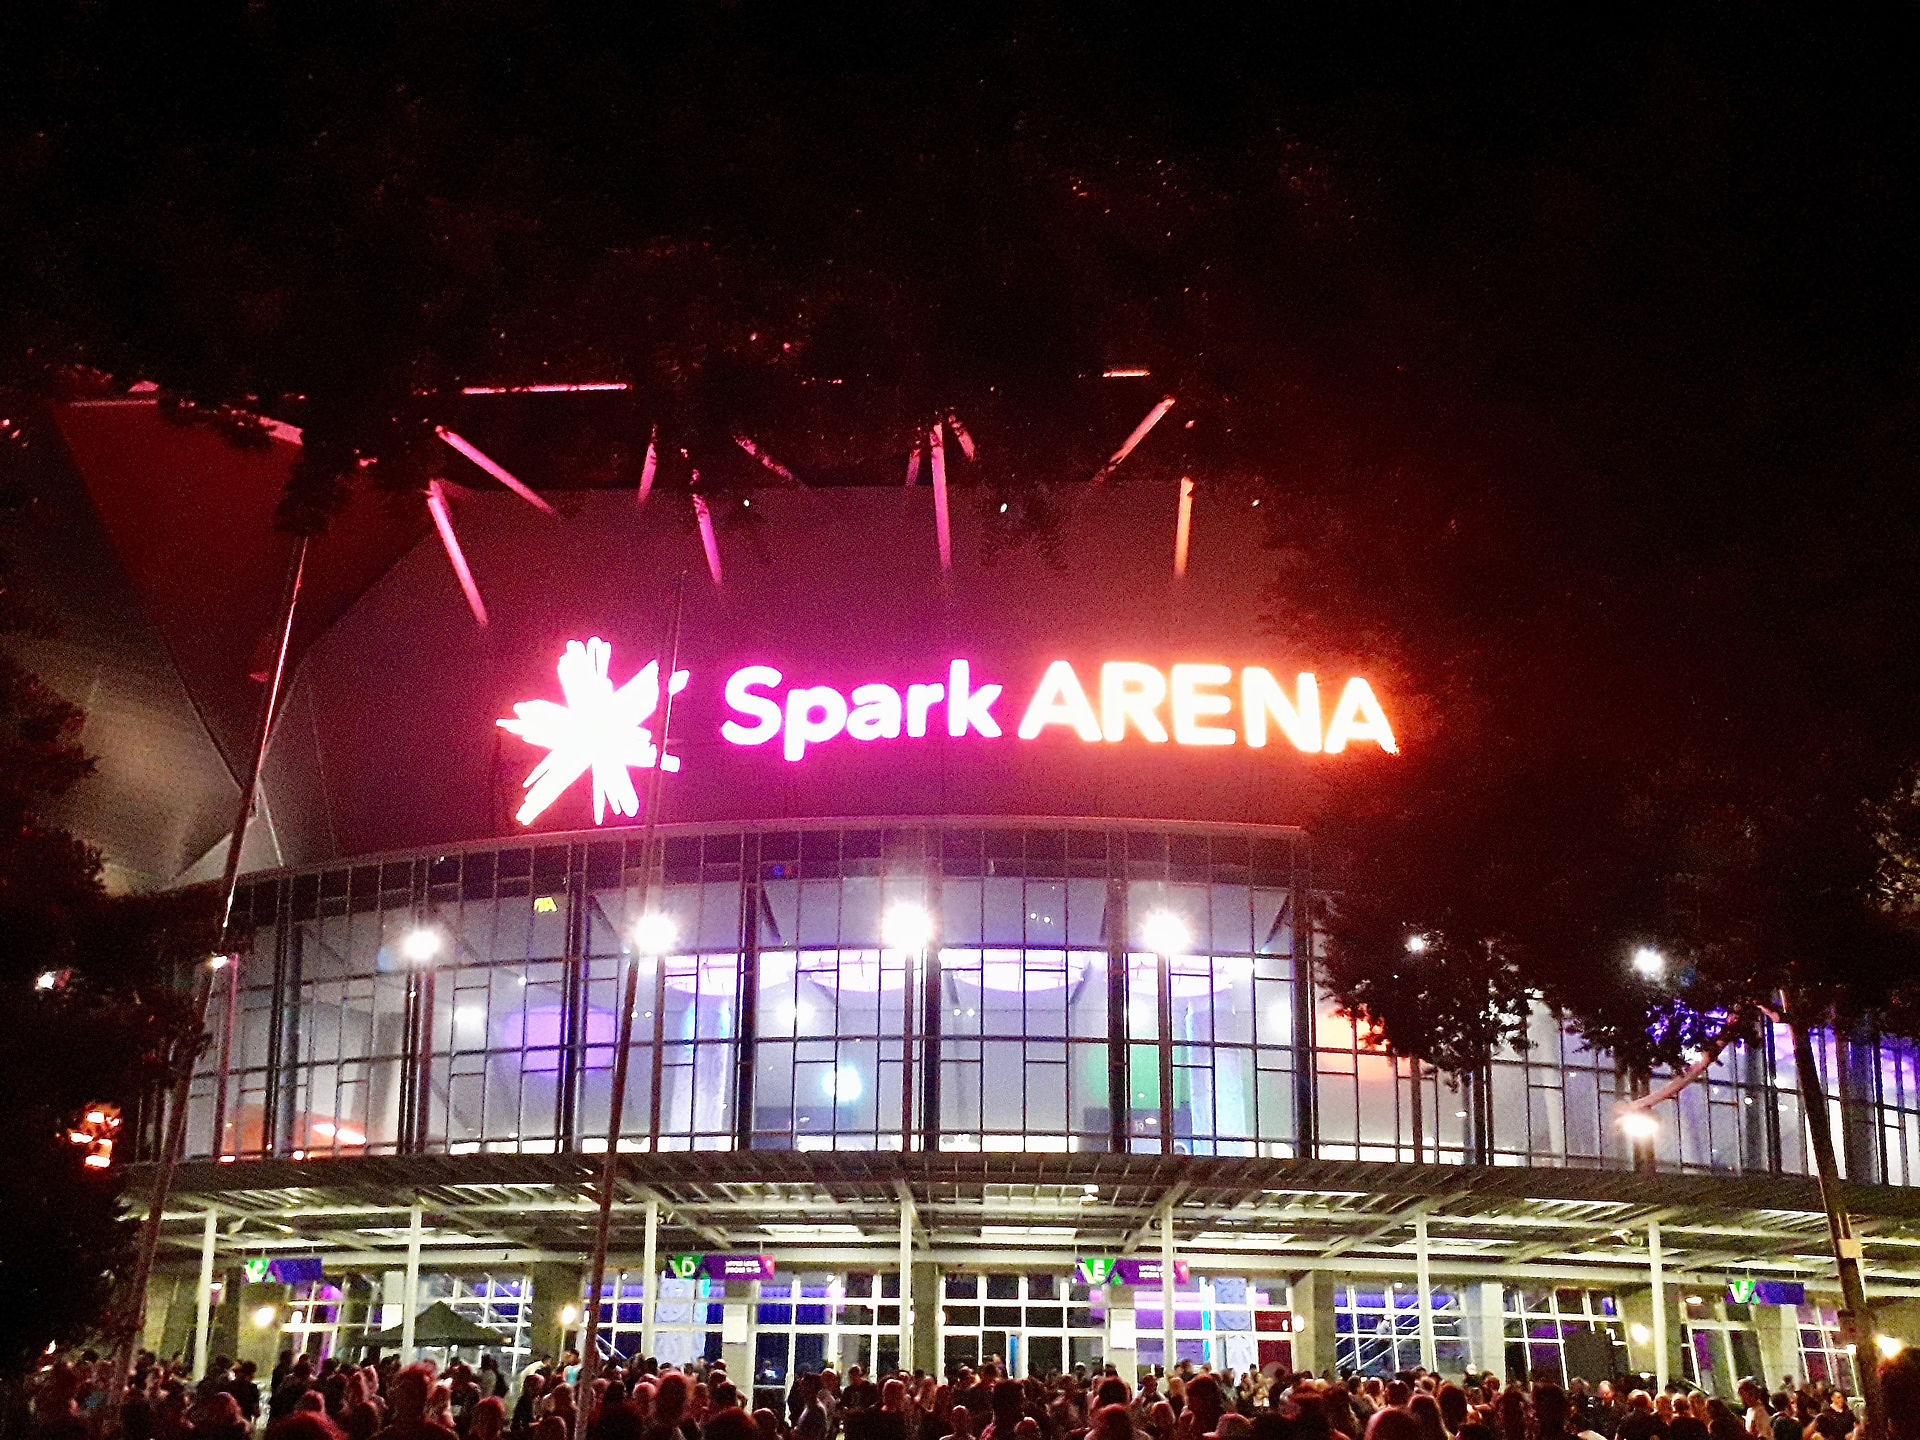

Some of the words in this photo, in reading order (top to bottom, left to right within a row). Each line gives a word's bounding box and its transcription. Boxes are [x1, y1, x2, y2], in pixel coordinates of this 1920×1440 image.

[720, 658, 1003, 762] Spark
[1017, 660, 1400, 755] ARENA
[681, 1259, 696, 1276] D
[1093, 1260, 1106, 1281] E
